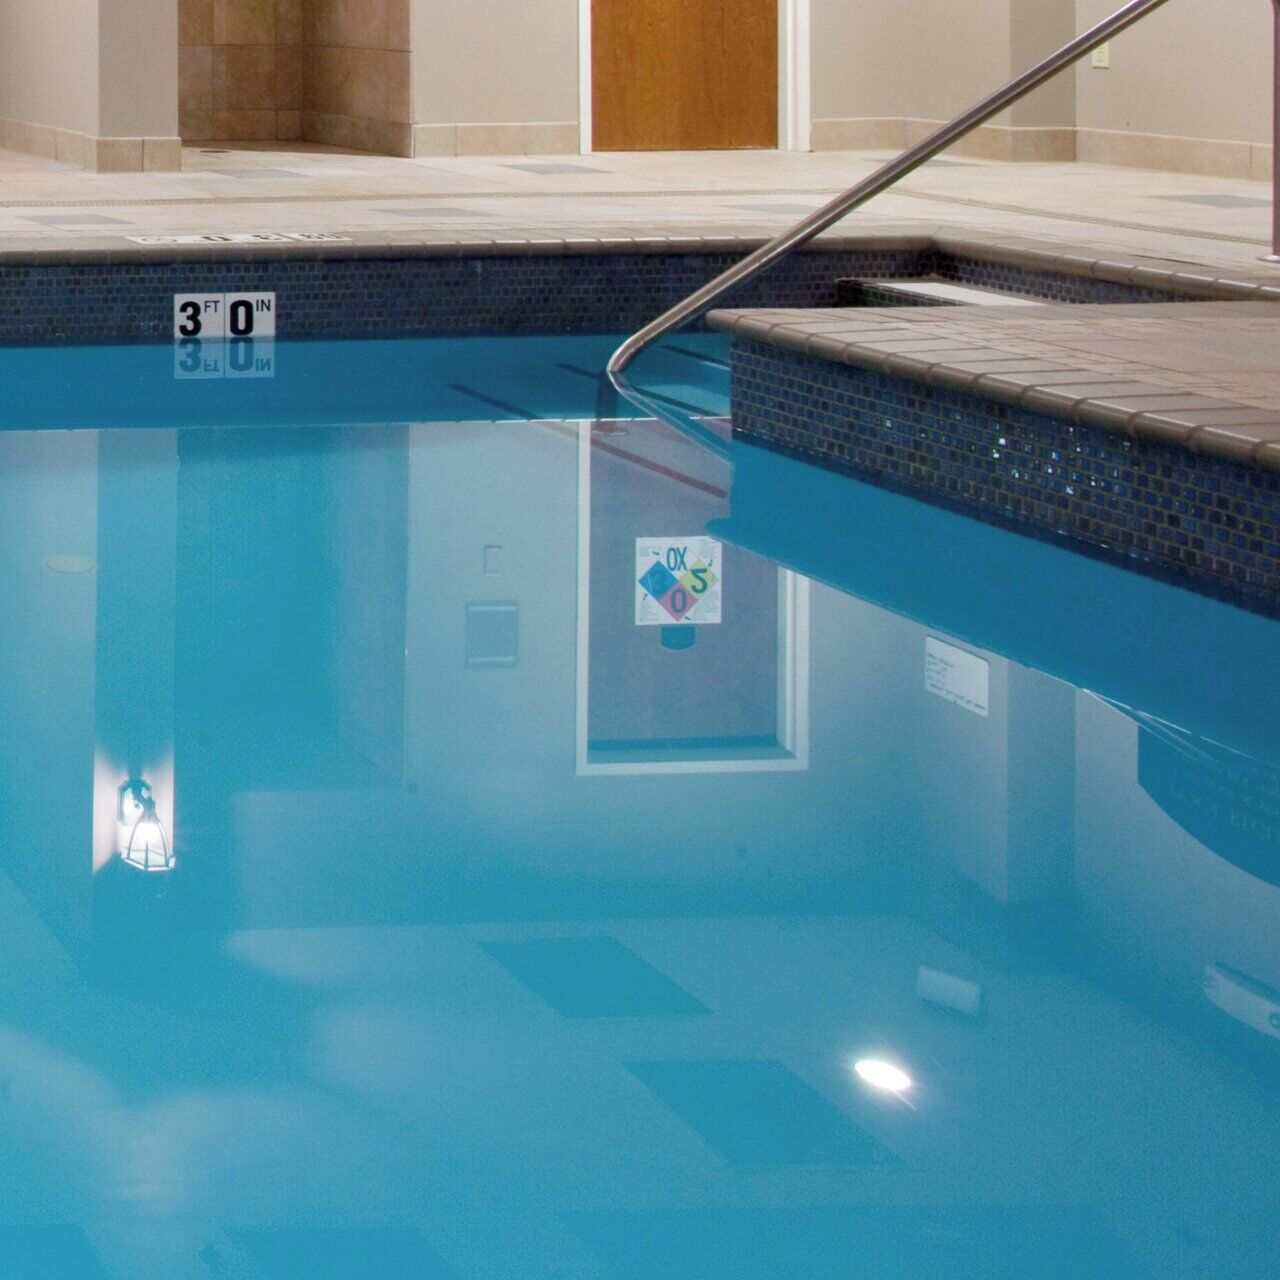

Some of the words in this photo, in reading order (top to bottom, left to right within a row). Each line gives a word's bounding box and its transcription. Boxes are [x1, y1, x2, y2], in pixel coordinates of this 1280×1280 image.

[179, 300, 202, 337] 3
[204, 300, 220, 313] FT
[229, 299, 254, 336] 0
[256, 299, 271, 312] IN
